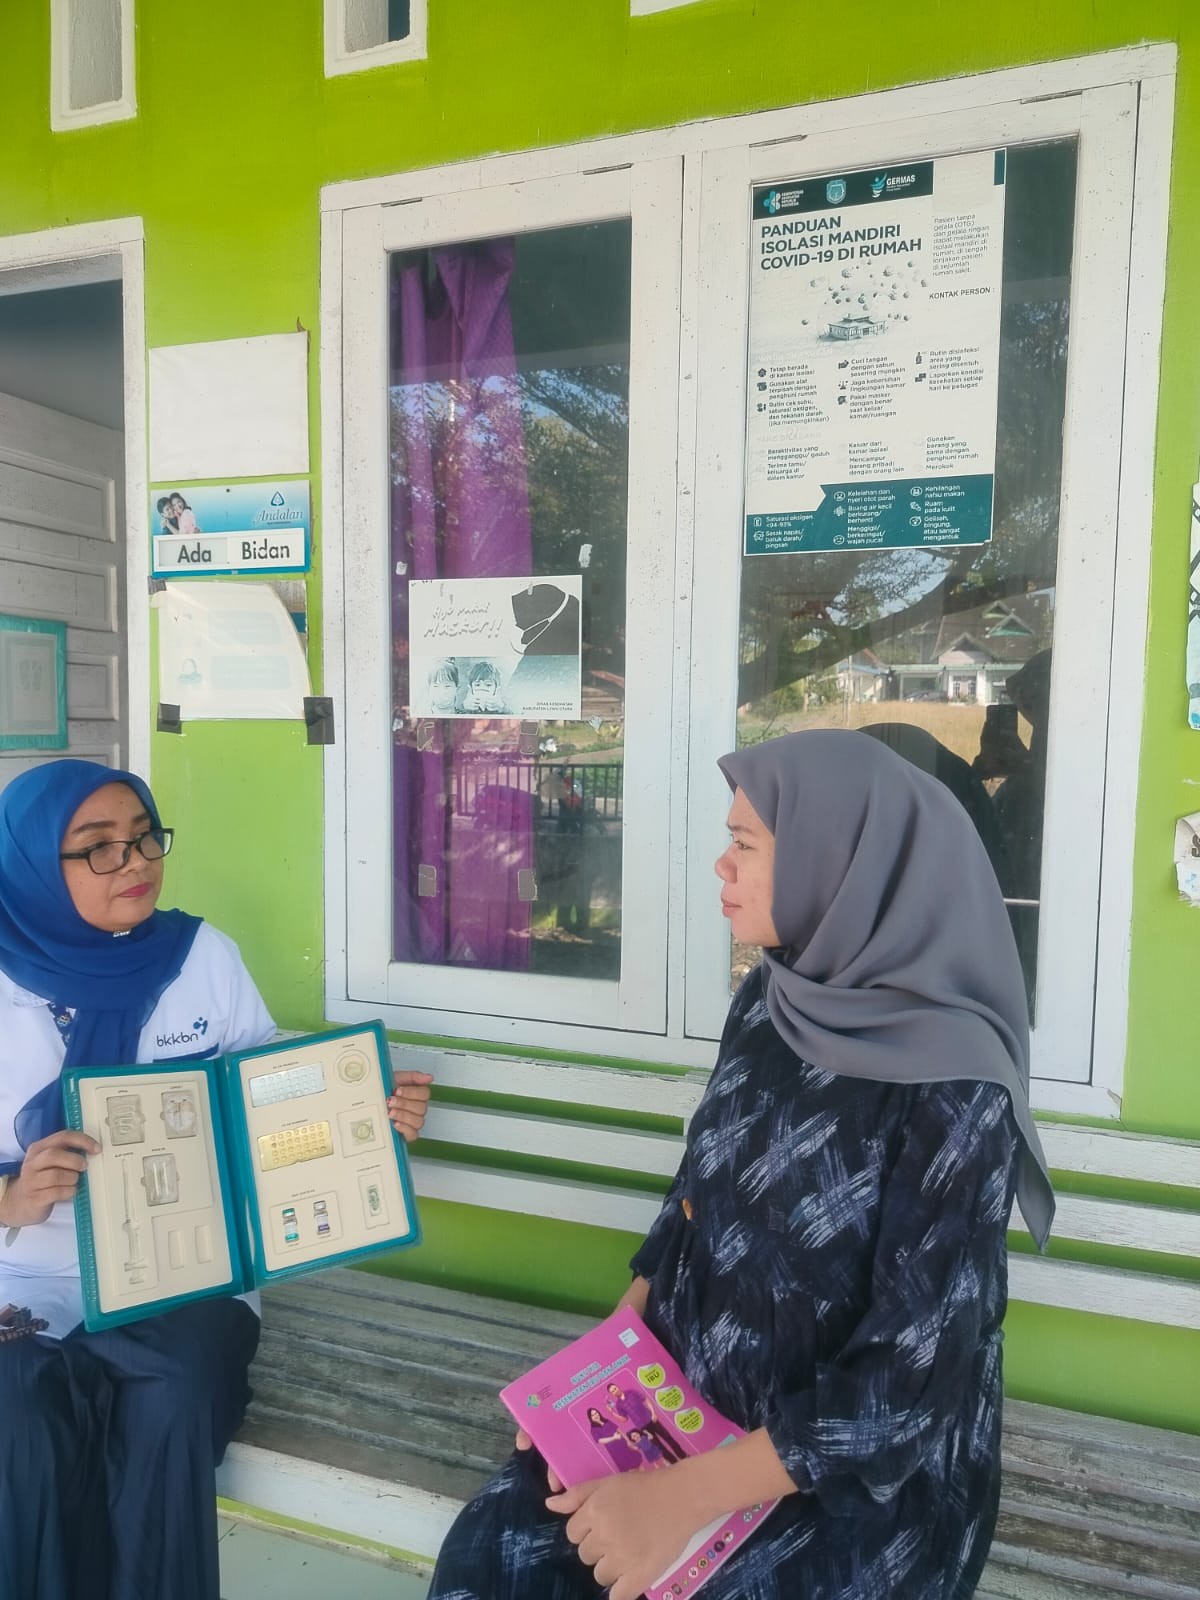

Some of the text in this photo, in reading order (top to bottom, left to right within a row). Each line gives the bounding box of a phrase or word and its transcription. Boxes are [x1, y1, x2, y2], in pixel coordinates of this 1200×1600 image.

[886, 174, 916, 186] GERMAS
[761, 216, 842, 238] PANDUAN
[761, 224, 901, 254] ISOLASI MANDIRI
[760, 238, 922, 272] COVID-19 DI RUMAH
[930, 287, 990, 300] KONTAK PERSON
[254, 508, 303, 523] Andalan
[177, 538, 290, 564] Ada Bidan
[156, 1032, 198, 1047] bkkbn
[648, 1371, 661, 1382] IBU
